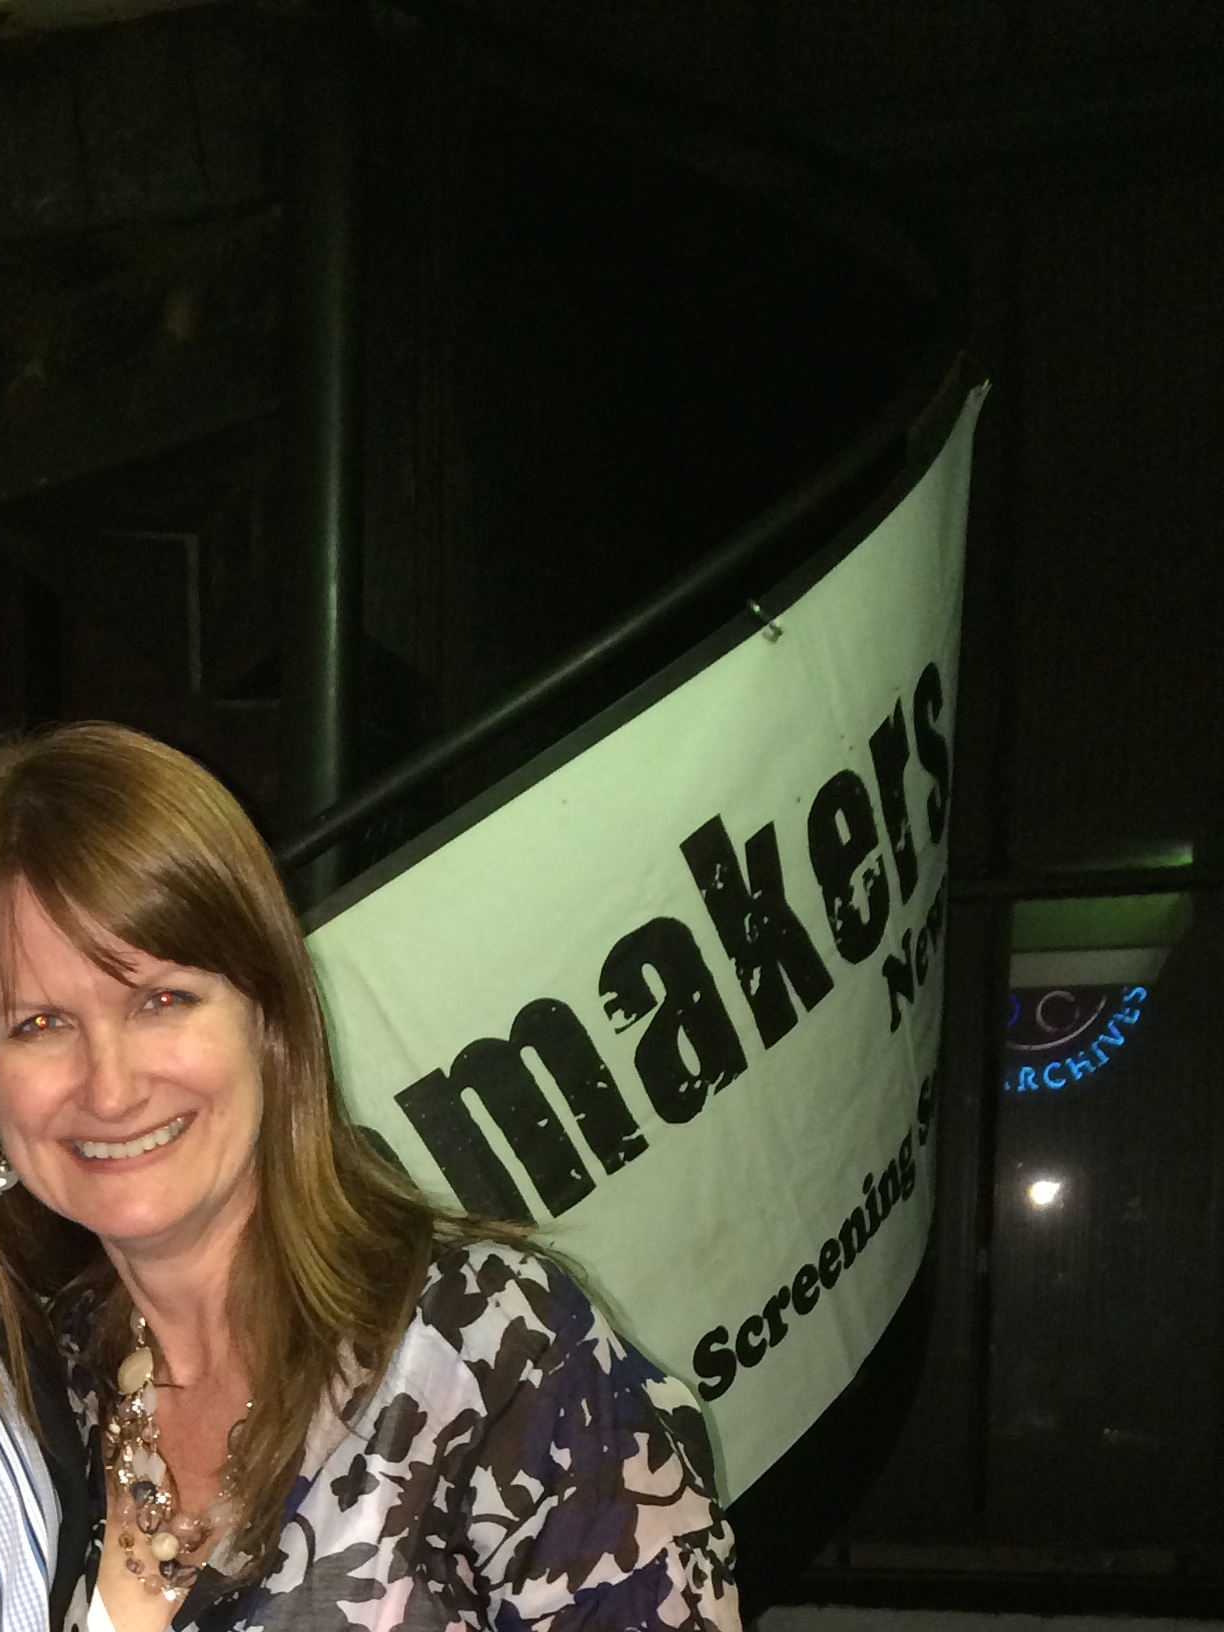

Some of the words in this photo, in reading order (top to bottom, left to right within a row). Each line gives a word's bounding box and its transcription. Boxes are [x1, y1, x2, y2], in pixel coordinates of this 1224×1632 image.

[354, 662, 948, 1226] makers
[1004, 986, 1148, 1092] RCHIVES
[693, 1122, 917, 1402] Screening
